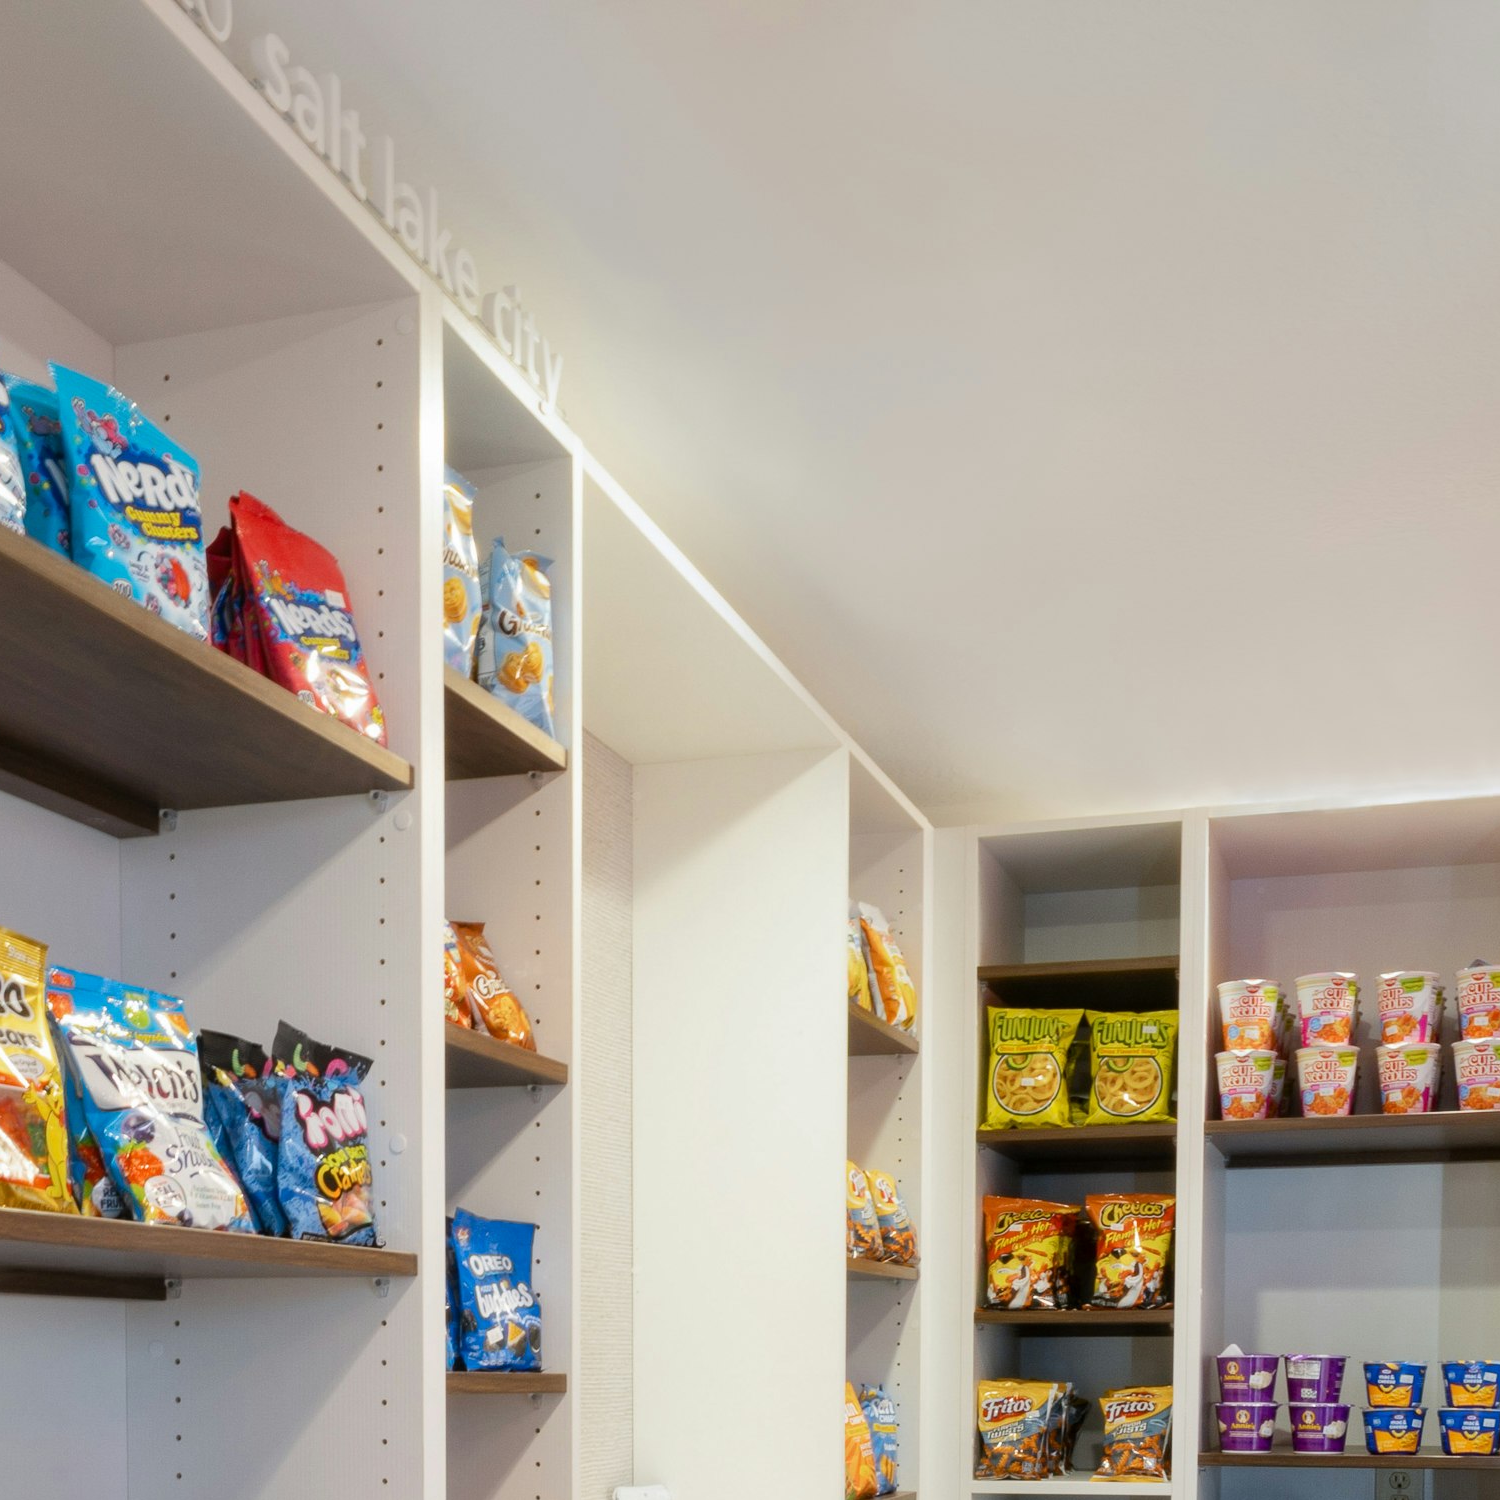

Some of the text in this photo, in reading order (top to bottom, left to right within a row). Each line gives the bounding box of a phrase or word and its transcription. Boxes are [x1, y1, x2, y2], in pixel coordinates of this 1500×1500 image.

[1467, 982, 1494, 994] CUP
[1239, 995, 1266, 1008] CUP
[1229, 1006, 1272, 1018] NOODLES
[1313, 1060, 1340, 1072] CUP
[1468, 1054, 1497, 1067] CUP
[1229, 1065, 1256, 1077] CUP
[1304, 1070, 1348, 1083] NOODLES
[1221, 1075, 1264, 1087] NOODLES
[1100, 1202, 1165, 1228] Cheetos
[1030, 1222, 1052, 1235] Hot
[1143, 1219, 1164, 1231] Hot
[468, 1254, 513, 1276] OREO
[981, 1394, 1032, 1422] Fritos
[1105, 1397, 1156, 1422] Fritos
